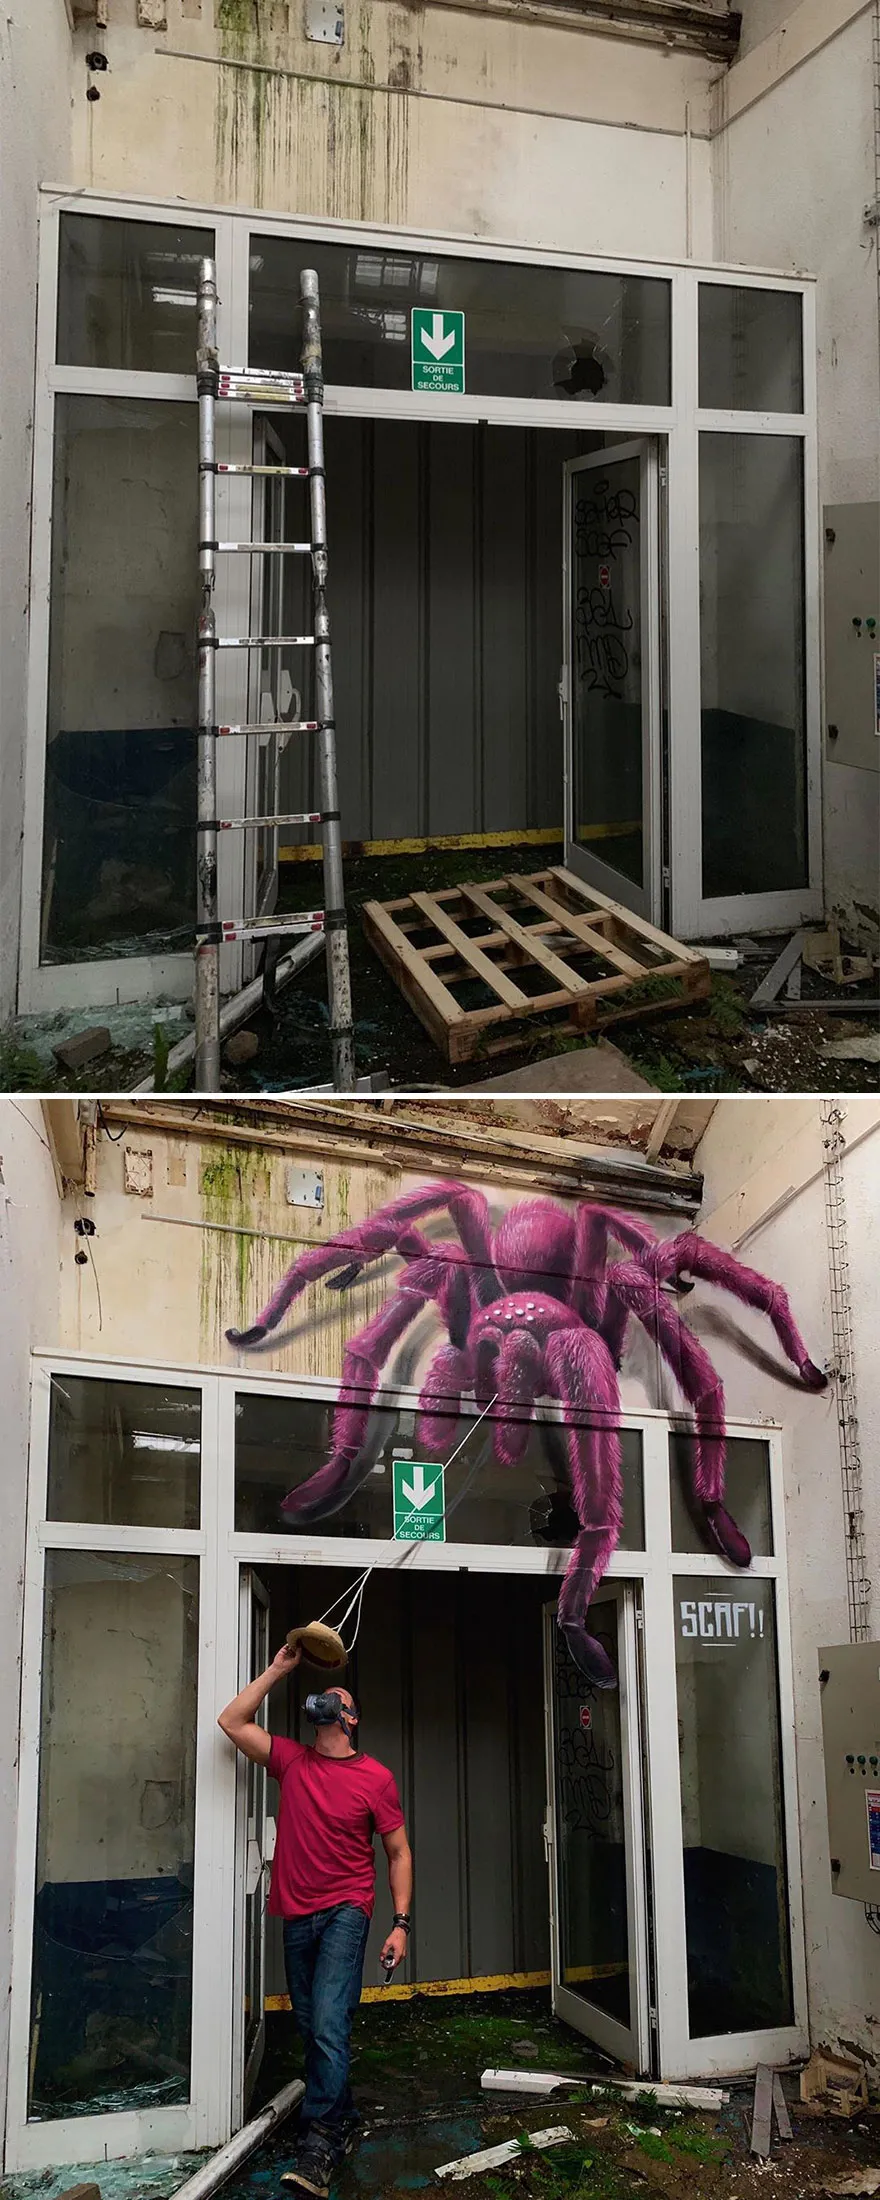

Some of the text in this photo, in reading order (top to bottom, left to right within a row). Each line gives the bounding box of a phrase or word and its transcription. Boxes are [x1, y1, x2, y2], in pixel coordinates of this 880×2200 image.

[422, 365, 454, 375] SORTIE
[432, 374, 444, 382] DE
[417, 381, 460, 391] SECOURS
[404, 1515, 435, 1525] SORTIE
[414, 1524, 425, 1532] DE
[399, 1531, 440, 1540] SECOURS
[680, 1601, 764, 1638] SCAF!!
